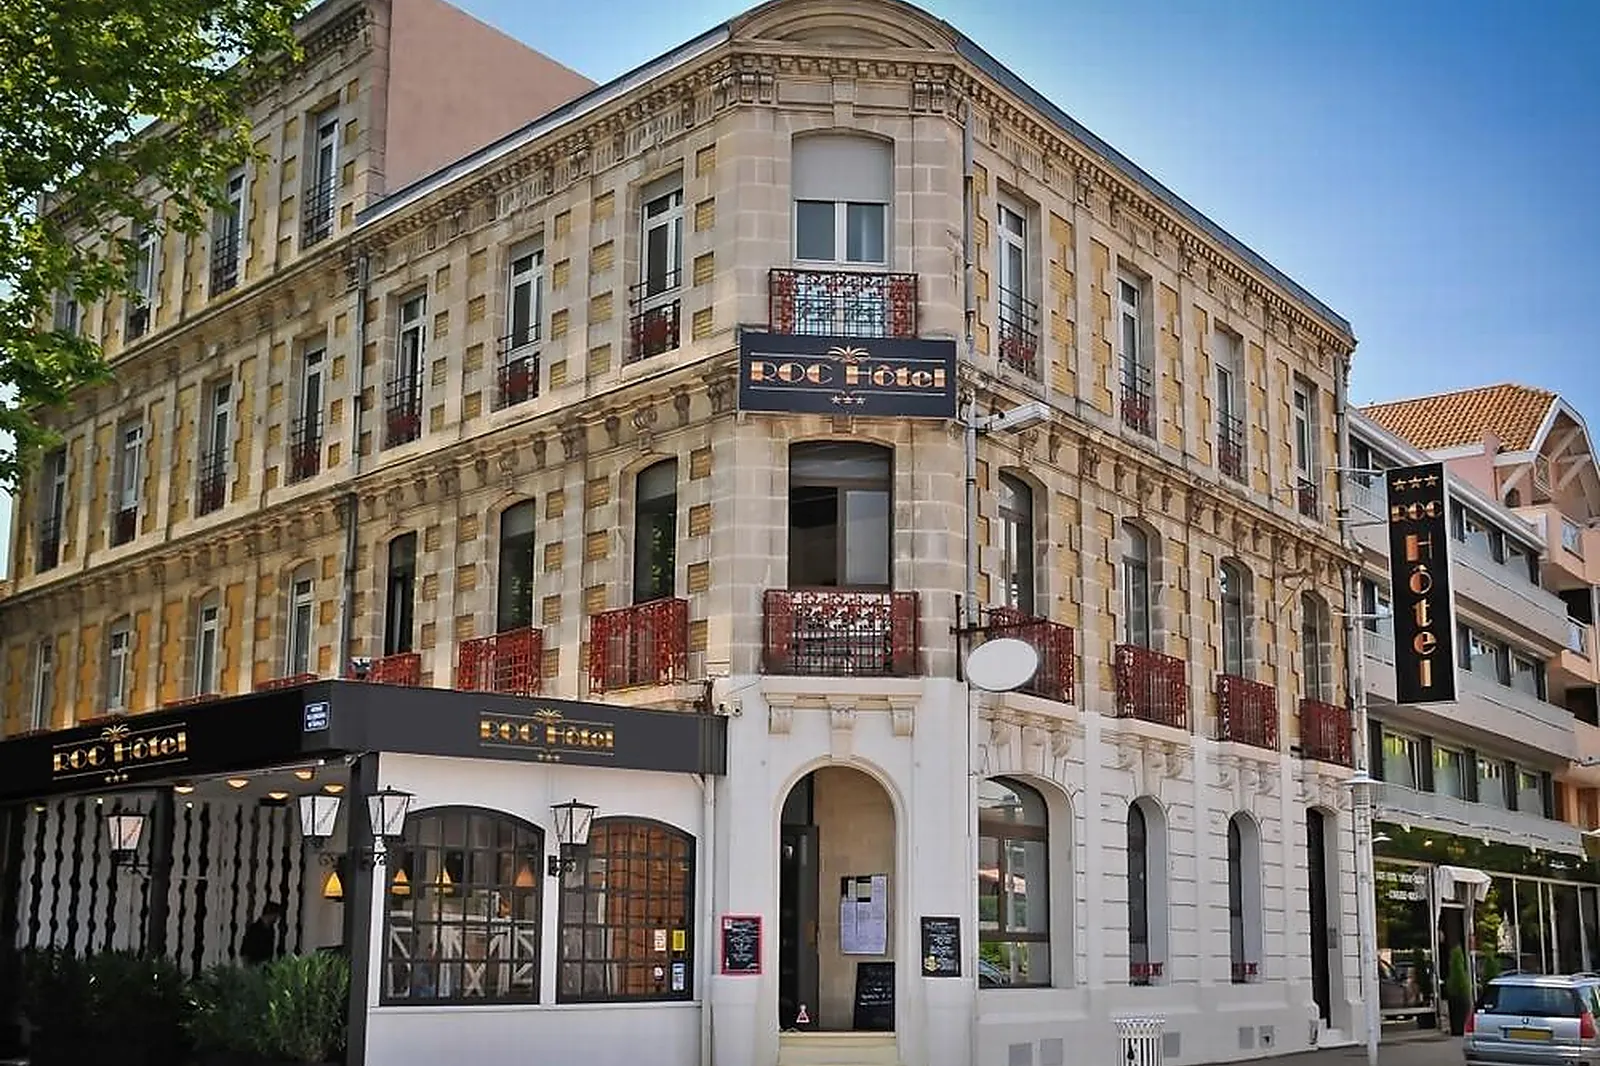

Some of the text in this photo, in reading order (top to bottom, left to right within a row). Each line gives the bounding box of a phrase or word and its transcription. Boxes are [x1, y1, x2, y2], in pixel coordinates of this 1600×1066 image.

[750, 360, 946, 388] ROC Hôtel
[1391, 501, 1442, 522] ROC
[1404, 531, 1437, 688] Hôtel
[480, 720, 614, 748] ROC Hôtel
[53, 731, 187, 772] ROC Hôtel
